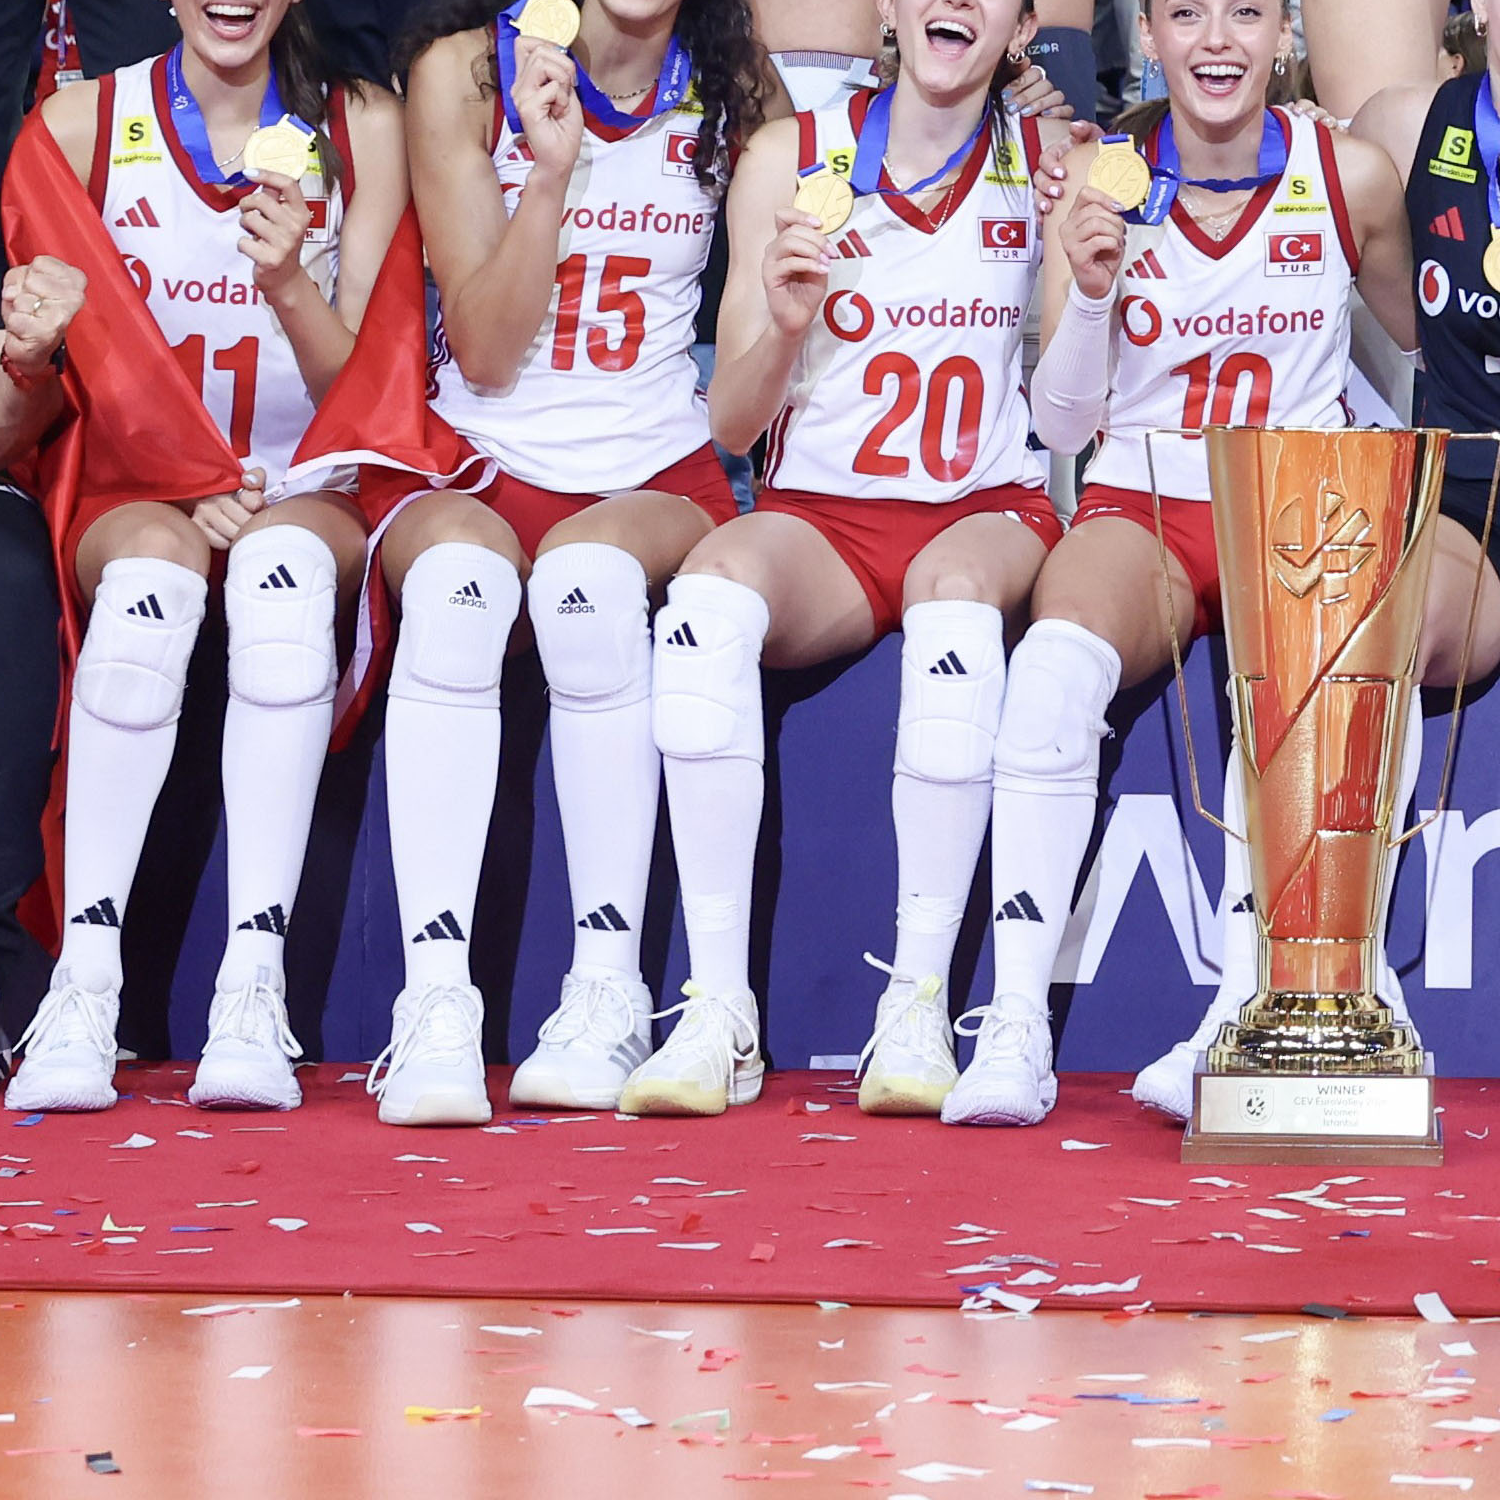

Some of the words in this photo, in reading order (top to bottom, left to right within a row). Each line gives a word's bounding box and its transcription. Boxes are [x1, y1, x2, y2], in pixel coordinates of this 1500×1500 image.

[129, 119, 145, 144] S
[1449, 133, 1466, 159] S
[833, 154, 850, 175] S
[1292, 178, 1307, 197] S
[561, 202, 703, 237] vodafone
[1273, 204, 1327, 214] sahibinden.com
[993, 249, 1020, 262] TUR
[1280, 262, 1311, 274] TUR
[550, 253, 653, 371] 15
[885, 298, 1021, 329] vodafone
[1172, 305, 1326, 339] vodafone
[168, 335, 259, 459] 11
[1169, 351, 1273, 441] 10
[851, 351, 986, 485] 20
[449, 596, 488, 610] adidas
[557, 602, 596, 615] adidas
[1316, 1084, 1366, 1096] WINNER
